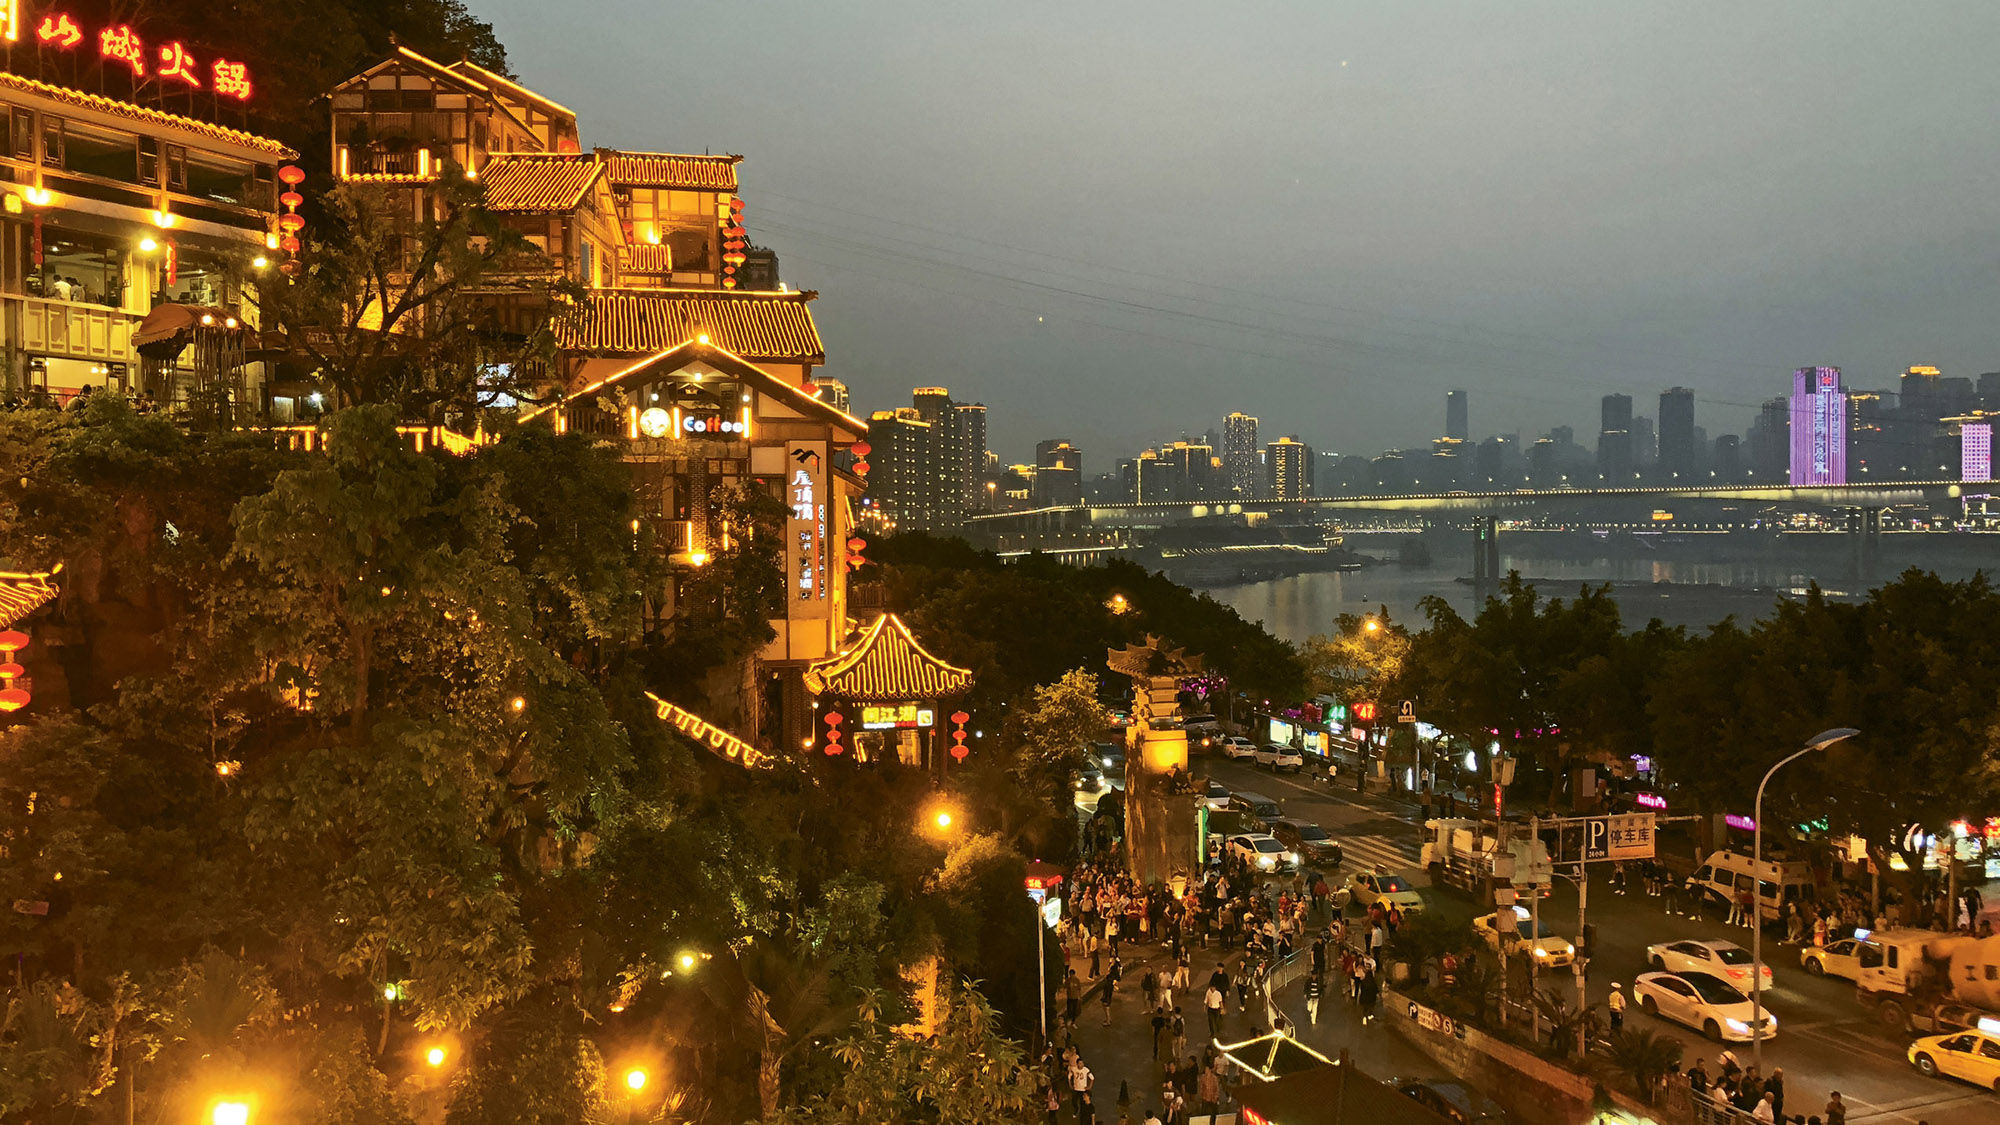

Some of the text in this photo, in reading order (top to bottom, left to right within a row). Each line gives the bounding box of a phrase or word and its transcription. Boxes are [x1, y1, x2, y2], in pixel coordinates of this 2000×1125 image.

[683, 415, 743, 433] Coffee
[1590, 821, 1605, 849] P
[1610, 827, 1650, 845] 停车库
